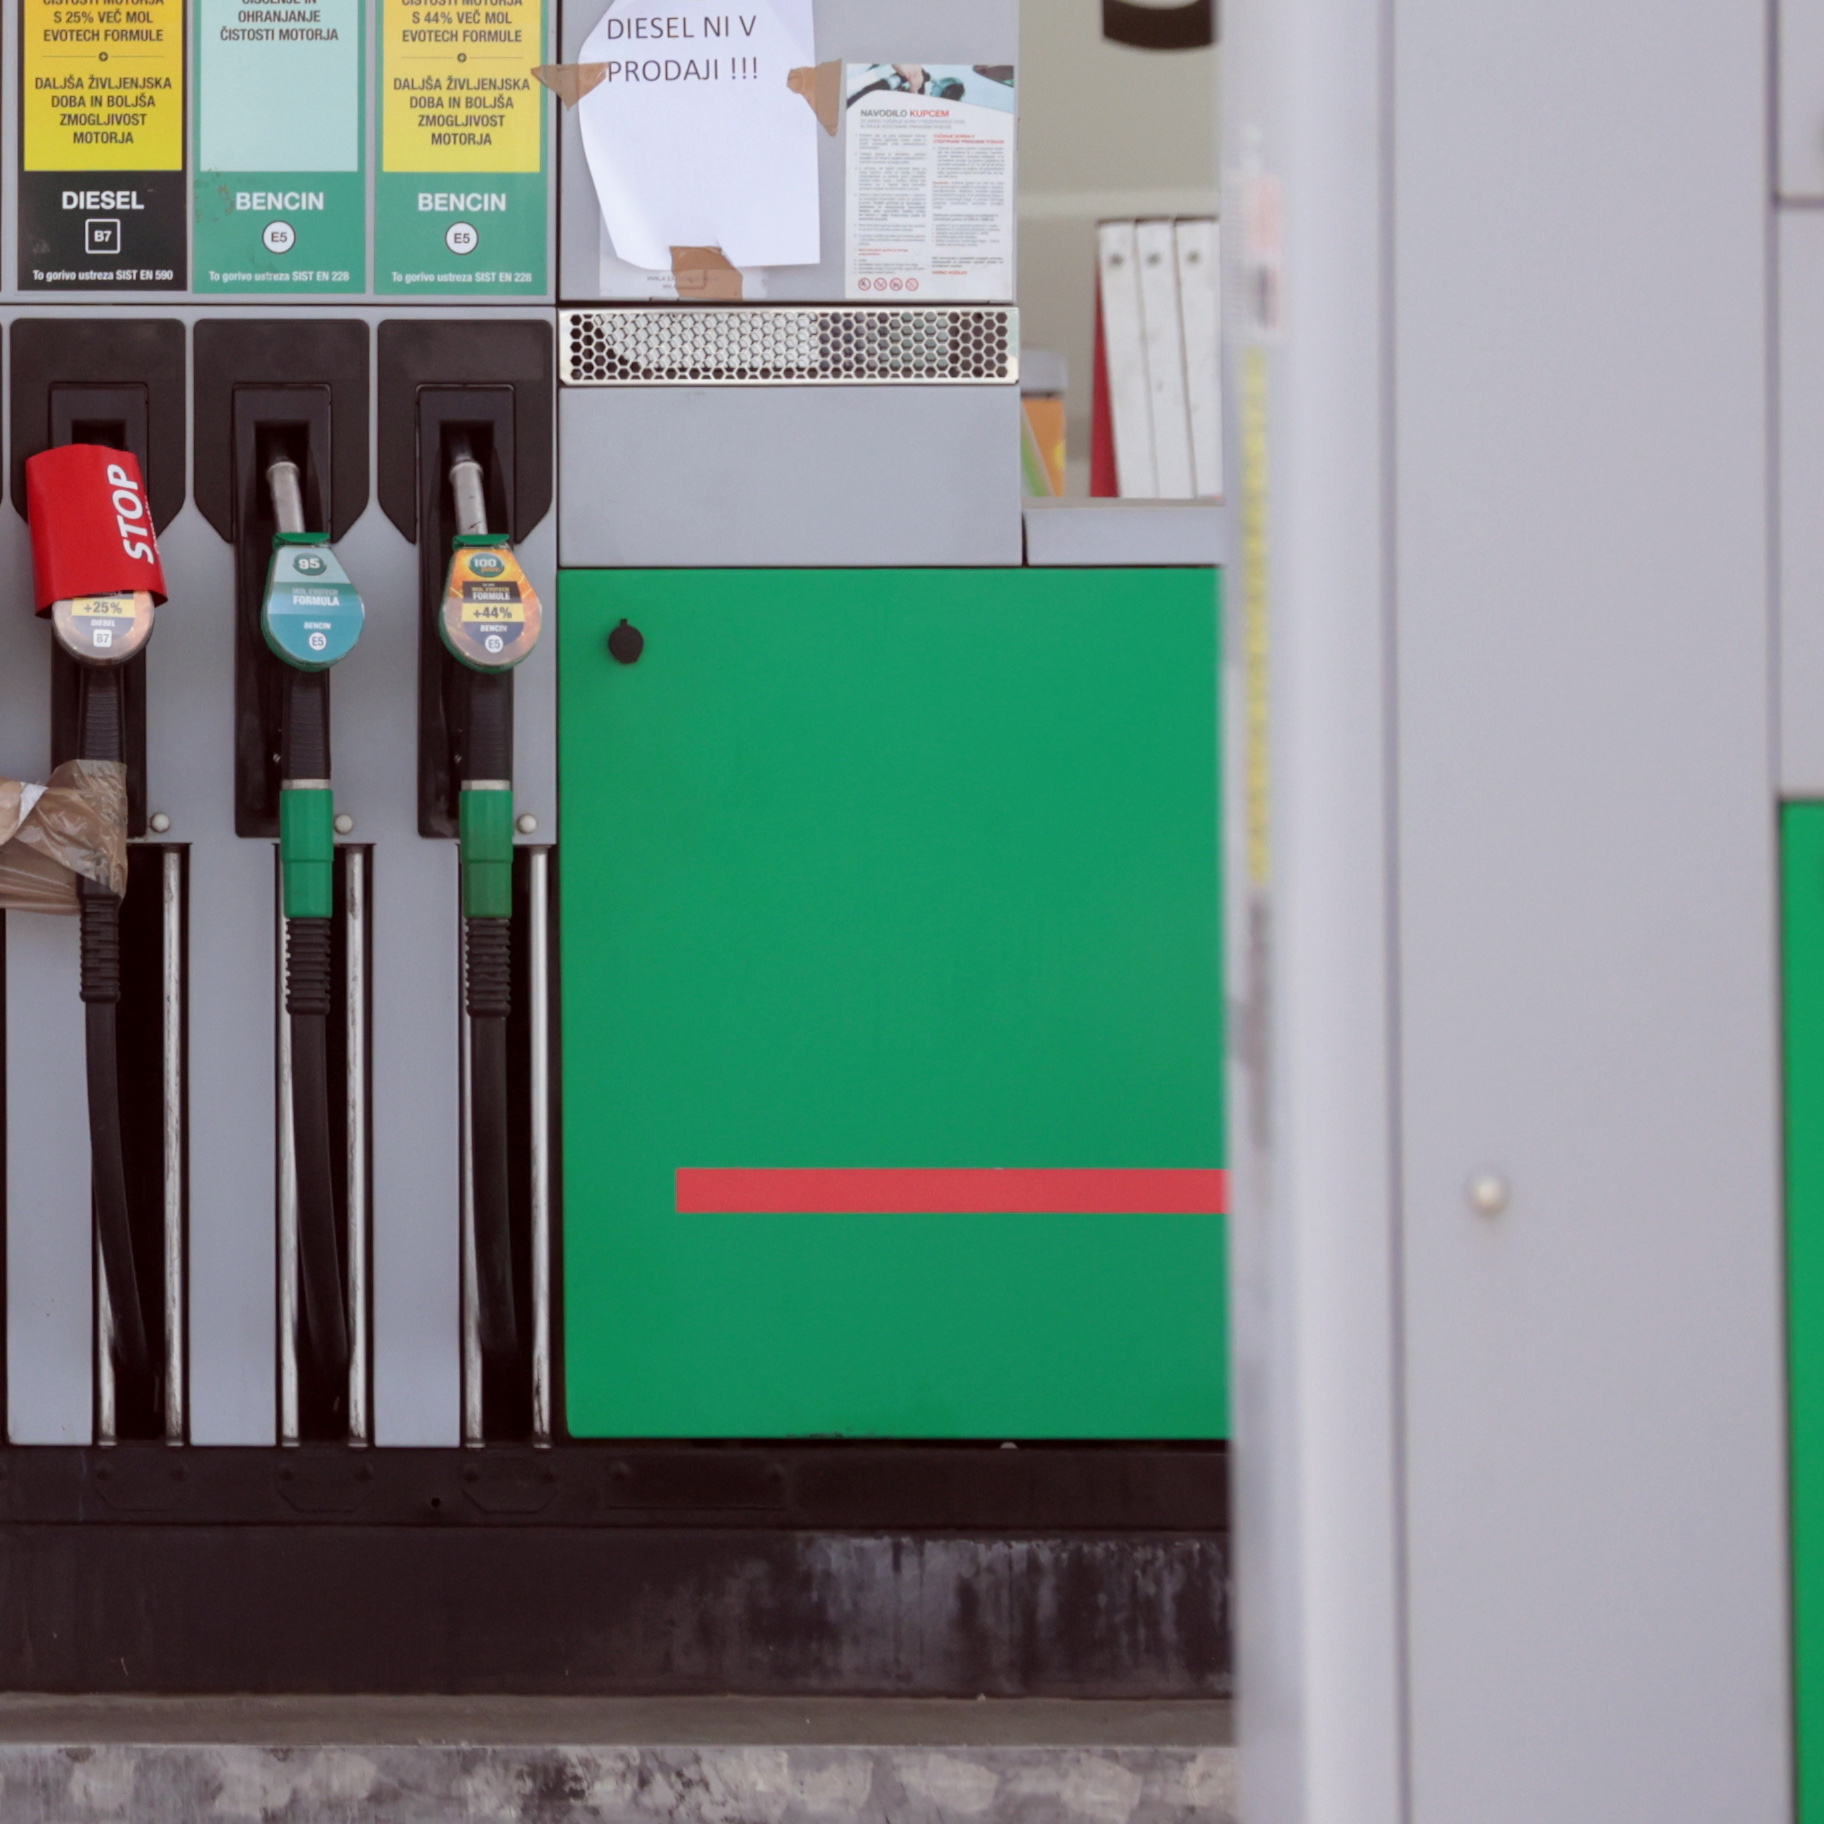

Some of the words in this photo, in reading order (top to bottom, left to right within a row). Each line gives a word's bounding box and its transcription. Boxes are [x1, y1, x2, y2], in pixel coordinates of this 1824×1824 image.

[53, 10, 62, 24] S
[65, 10, 94, 24] 25%
[97, 7, 122, 24] VEČ
[125, 10, 154, 24] MOL
[237, 9, 321, 23] OHRANJANJE
[411, 10, 421, 25] S
[423, 11, 453, 25] 44%
[456, 8, 481, 25] VEČ
[484, 11, 513, 25] MOL
[219, 25, 275, 41] ČISTOSTI
[278, 28, 339, 41] MOTORJA
[607, 15, 694, 40] DIESEL
[703, 15, 730, 38] NI
[738, 14, 757, 37] V
[43, 28, 100, 42] EVOTECH
[103, 28, 164, 42] FORMULE
[401, 29, 459, 43] EVOTECH
[462, 29, 522, 43] FORMULE
[607, 58, 719, 83] PRODAJI
[731, 56, 758, 80] !!!
[34, 74, 85, 90] DALJŠA
[87, 73, 172, 90] ŽIVLJENJSKA
[393, 75, 443, 91] DALJŠA
[445, 74, 531, 91] ŽIVLJENJSKA
[51, 95, 87, 108] DOBA
[90, 95, 103, 108] IN
[106, 92, 156, 108] BOLJŠA
[409, 95, 445, 109] DOBA
[448, 96, 461, 109] IN
[464, 93, 514, 110] BOLJŠA
[59, 112, 148, 127] ZMOGLJIVOST
[417, 113, 506, 128] ZMOGLJIVOST
[860, 109, 908, 118] NAVODILO
[909, 109, 950, 118] KUPCEM
[72, 131, 135, 145] MOTORJA
[430, 132, 492, 146] MOTORJA
[61, 190, 145, 210] DIESEL
[235, 191, 324, 211] BENCIN
[417, 192, 507, 212] BENCIN
[94, 229, 112, 243] B7
[270, 231, 288, 243] E5
[453, 232, 471, 244] E5
[32, 269, 45, 281] To
[45, 269, 77, 283] gorivo
[77, 270, 115, 281] ustreza
[115, 269, 139, 281] SIST
[139, 269, 154, 281] EN
[154, 269, 174, 281] 590
[208, 270, 221, 282] To
[221, 271, 253, 284] gorivo
[253, 271, 291, 282] ustreza
[291, 270, 315, 282] SIST
[315, 270, 330, 282] EN
[331, 270, 350, 282] 228
[391, 271, 404, 283] To
[404, 271, 436, 285] gorivo
[436, 272, 473, 283] ustreza
[474, 271, 497, 283] SIST
[498, 271, 513, 283] EN
[513, 272, 533, 283] 228
[107, 464, 155, 565] STOP
[298, 557, 321, 570] 95
[83, 601, 123, 615] +25%
[292, 595, 341, 607] FORMULA
[473, 606, 513, 619] +44%
